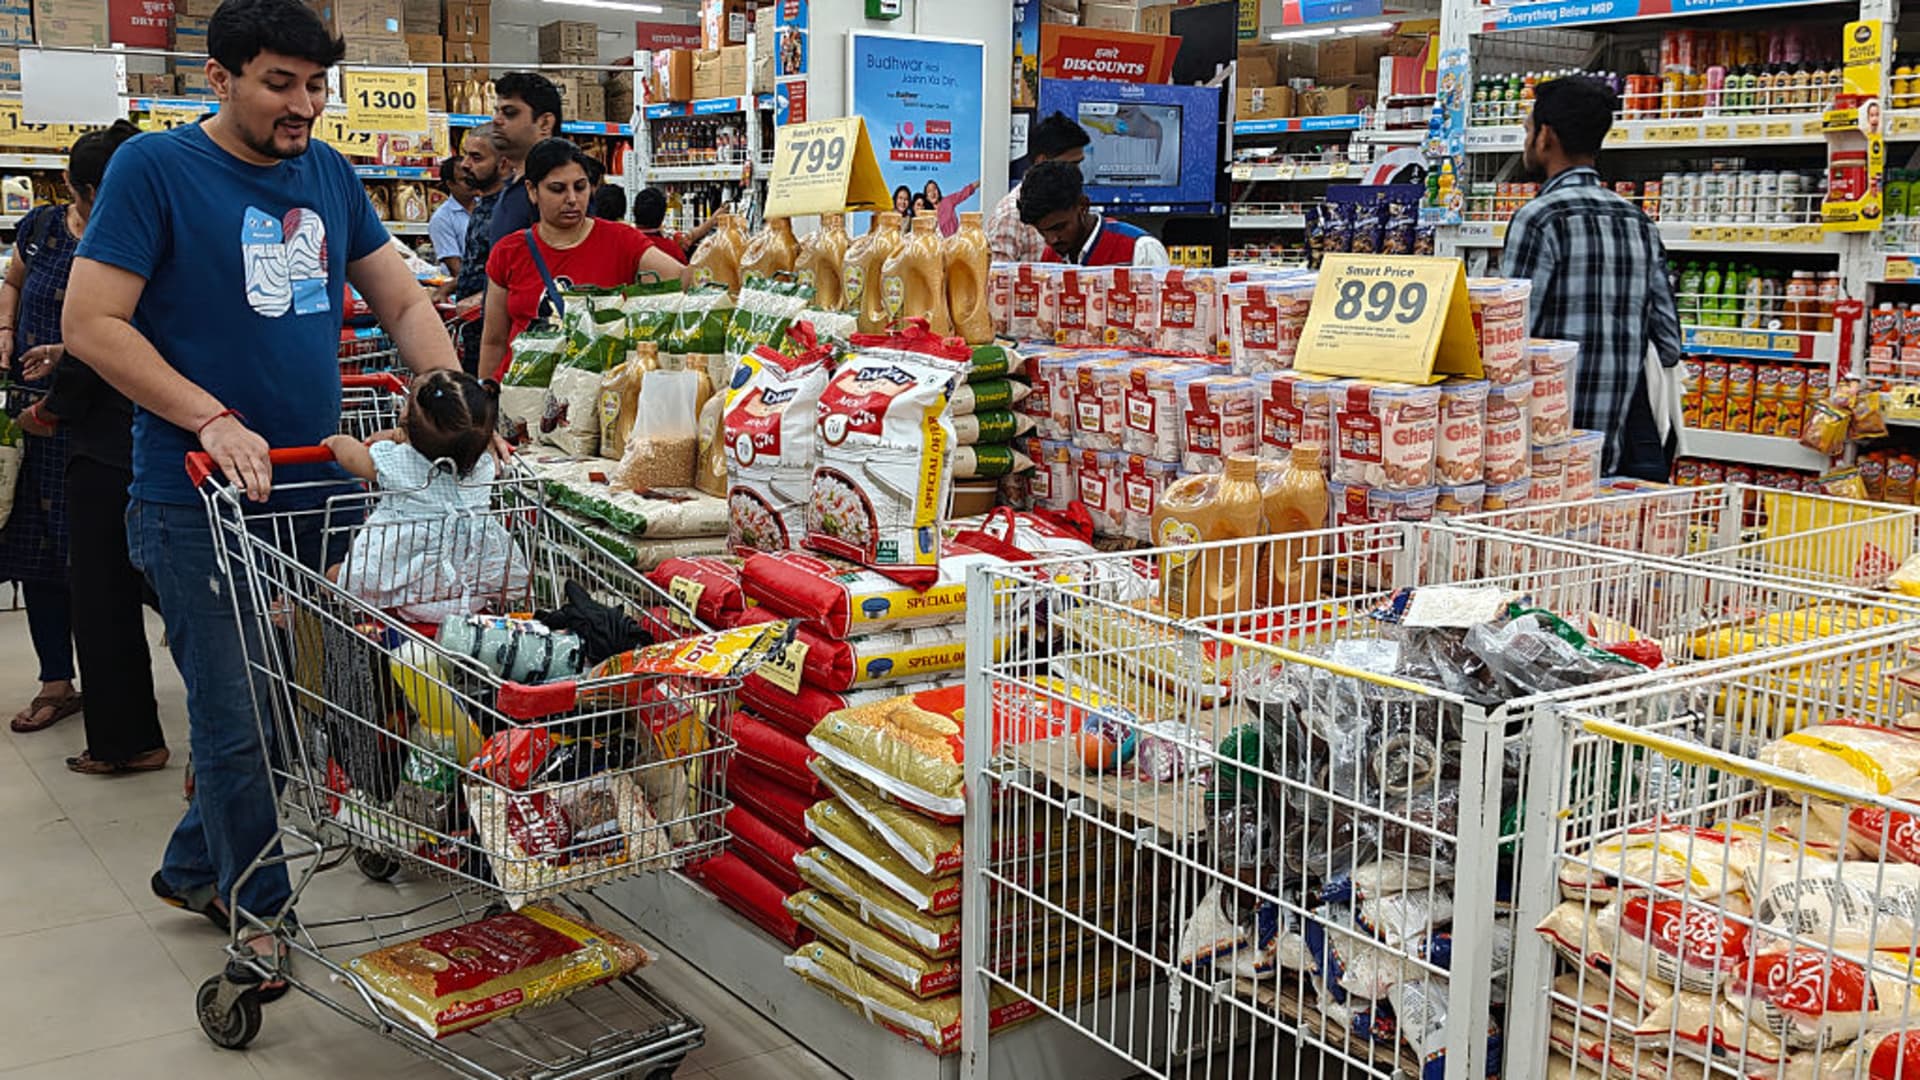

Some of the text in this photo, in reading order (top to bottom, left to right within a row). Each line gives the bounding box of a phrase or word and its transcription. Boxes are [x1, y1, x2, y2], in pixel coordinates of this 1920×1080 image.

[131, 16, 154, 26] DRY
[1507, 2, 1613, 23] Everything Below MRP
[867, 53, 922, 72] Budhwar
[1062, 57, 1145, 75] DISCOUNTS
[1345, 265, 1415, 277] Smart Price
[1484, 327, 1524, 346] Ghee
[1393, 427, 1435, 446] Ghee
[924, 457, 939, 509] SPECIAL
[907, 594, 952, 609] SPECIAL
[908, 653, 950, 668] SPECIAL
